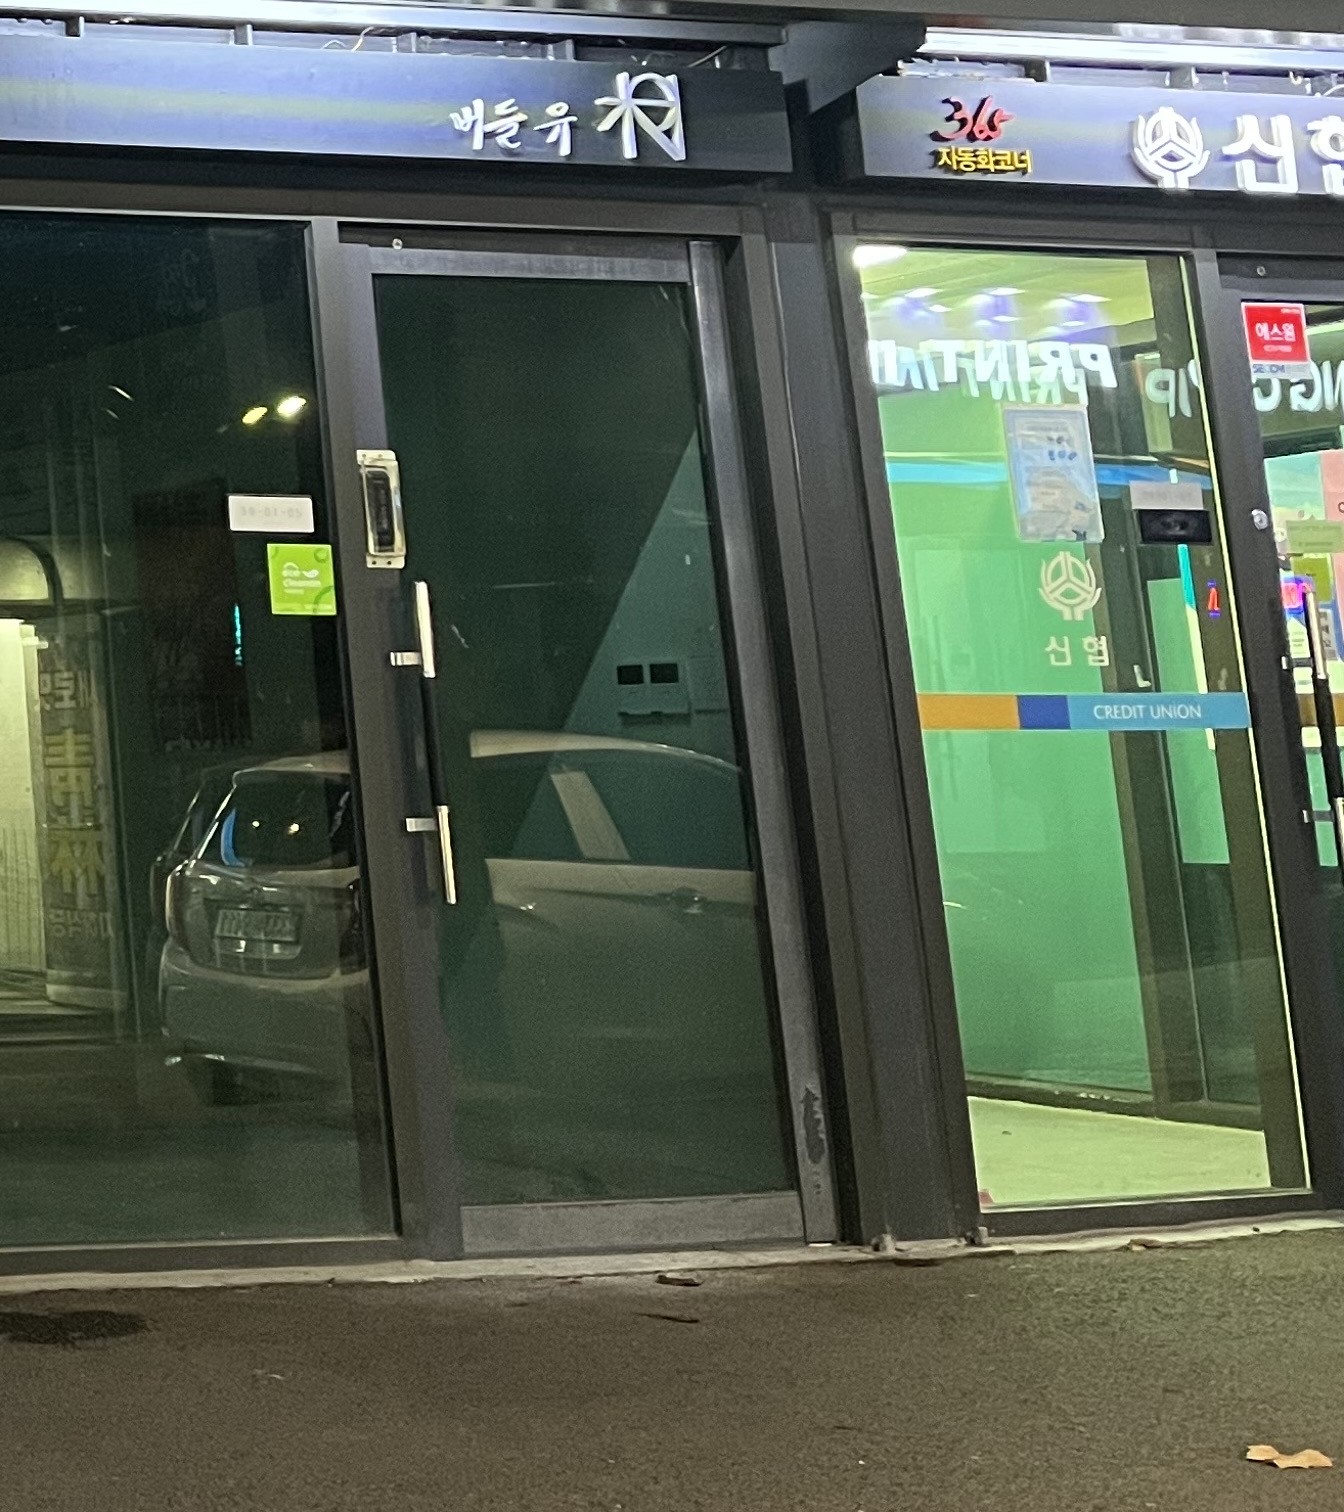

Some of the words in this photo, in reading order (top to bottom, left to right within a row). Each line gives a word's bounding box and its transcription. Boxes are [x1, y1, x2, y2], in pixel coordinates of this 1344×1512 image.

[449, 97, 528, 151] 버들
[532, 100, 578, 156] 유
[938, 145, 1032, 173] 자동화코너
[1044, 635, 1111, 667] 신협
[1093, 704, 1147, 720] CREDIT
[1150, 703, 1202, 719] UNION
